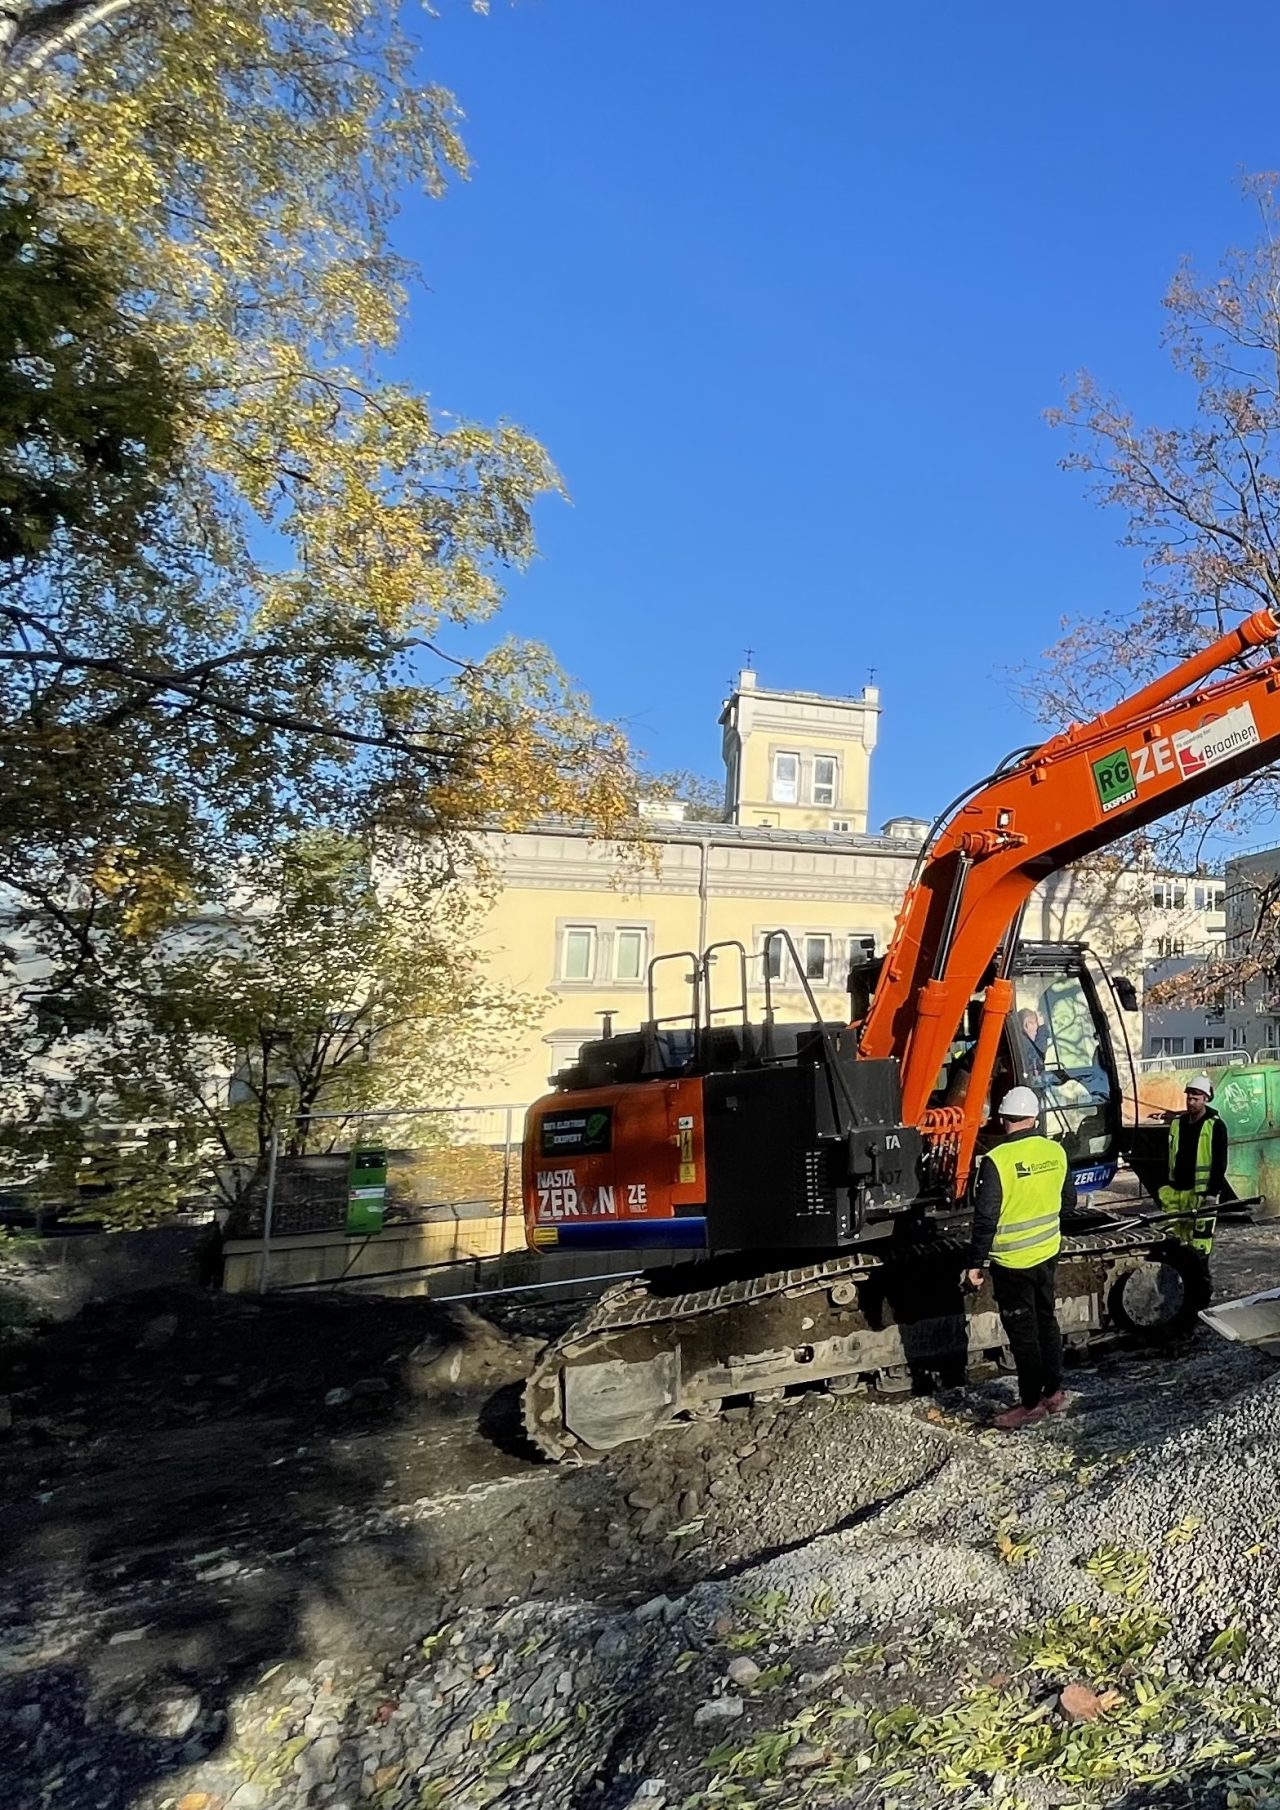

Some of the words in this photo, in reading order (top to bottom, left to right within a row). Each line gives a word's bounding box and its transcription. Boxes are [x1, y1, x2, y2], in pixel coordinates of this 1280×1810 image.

[1204, 725, 1256, 759] Braathen
[1098, 760, 1129, 793] RG
[1103, 789, 1137, 813] EKSPERT
[537, 1169, 576, 1189] NASTA
[627, 1184, 647, 1204] ZE
